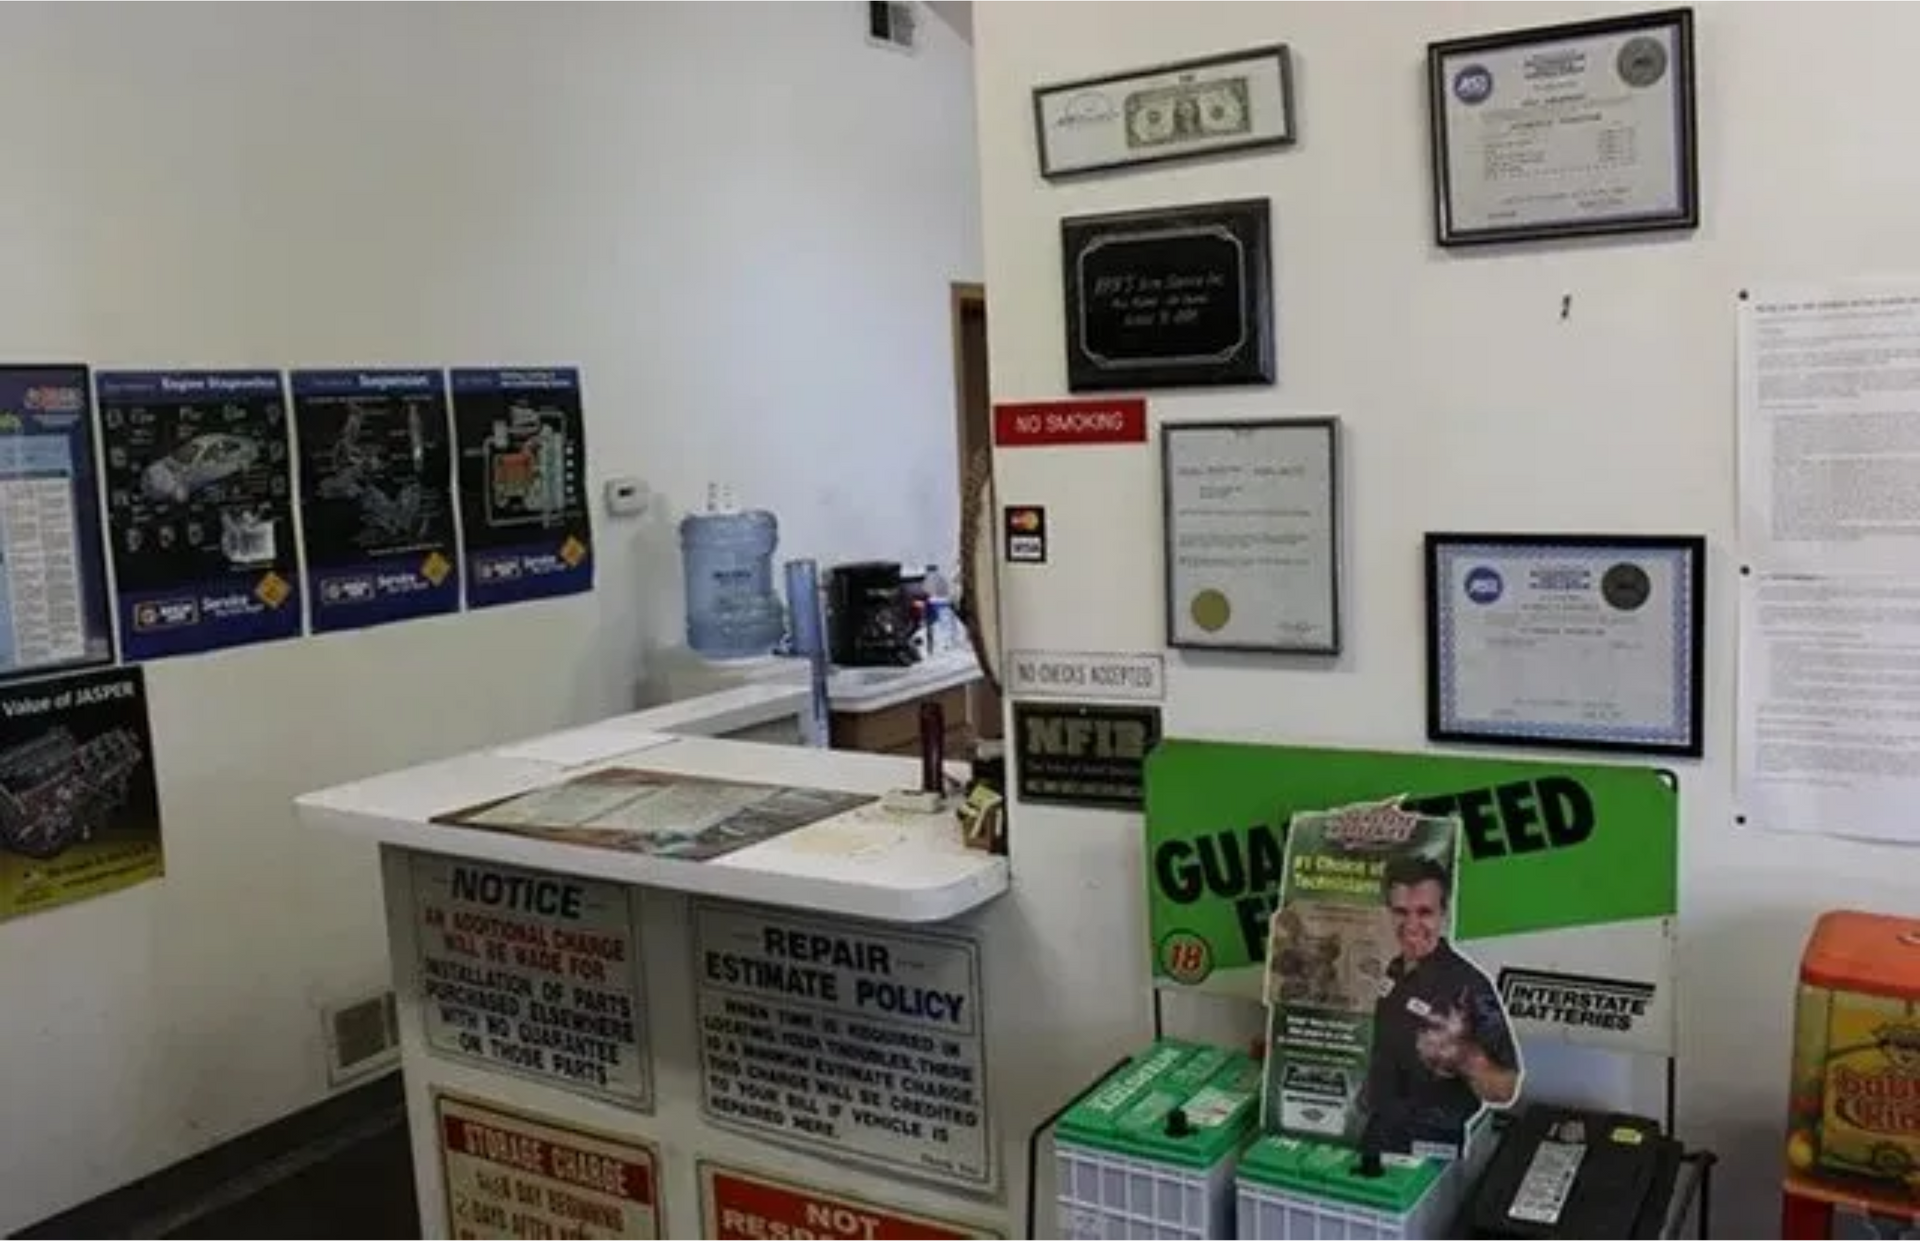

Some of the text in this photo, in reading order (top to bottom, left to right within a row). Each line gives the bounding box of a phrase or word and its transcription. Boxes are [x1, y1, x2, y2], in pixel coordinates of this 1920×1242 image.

[358, 374, 430, 390] Suspension
[1015, 411, 1123, 434] NO SMOKING
[1018, 662, 1152, 689] NO CHECKS ACCEPTED
[2, 681, 135, 717] Value of JASPER
[452, 867, 584, 919] NOTICE
[454, 911, 551, 948] ADDITIONAL
[551, 928, 626, 963] CHARGE
[762, 927, 892, 976] REPAIR
[425, 956, 632, 1020] INSTALLATION OF PARTS
[570, 956, 607, 984] FOR
[704, 950, 965, 1023] ESTIMATE POLICY
[425, 978, 635, 1044] PURCHASED ELSEWHERE
[1508, 1002, 1632, 1031] BATTERIES
[1514, 984, 1647, 1016] INTERSTATE
[486, 1015, 511, 1037] NO
[704, 1015, 776, 1042] LOCATING
[724, 1000, 769, 1020] WHEN
[778, 1011, 813, 1028] TIME
[823, 1018, 838, 1034] IS
[848, 1023, 934, 1053] REQUIRED
[458, 1031, 607, 1086] ON THOSE PARTS
[706, 1035, 722, 1051] IS
[727, 1040, 737, 1055] A
[815, 1056, 895, 1089] ESTIMATE
[709, 1074, 729, 1092] TO
[737, 1081, 779, 1102] YOUR
[786, 1093, 819, 1115] BILL
[852, 1107, 922, 1138] VEHICLE
[932, 1127, 949, 1143] IS
[710, 1096, 785, 1126] REPAIRED
[746, 1065, 809, 1093] CHARGE
[815, 1079, 853, 1102] WILL
[859, 1089, 880, 1107] BE
[889, 1094, 979, 1127] CREDITED
[805, 1203, 881, 1240] NOT
